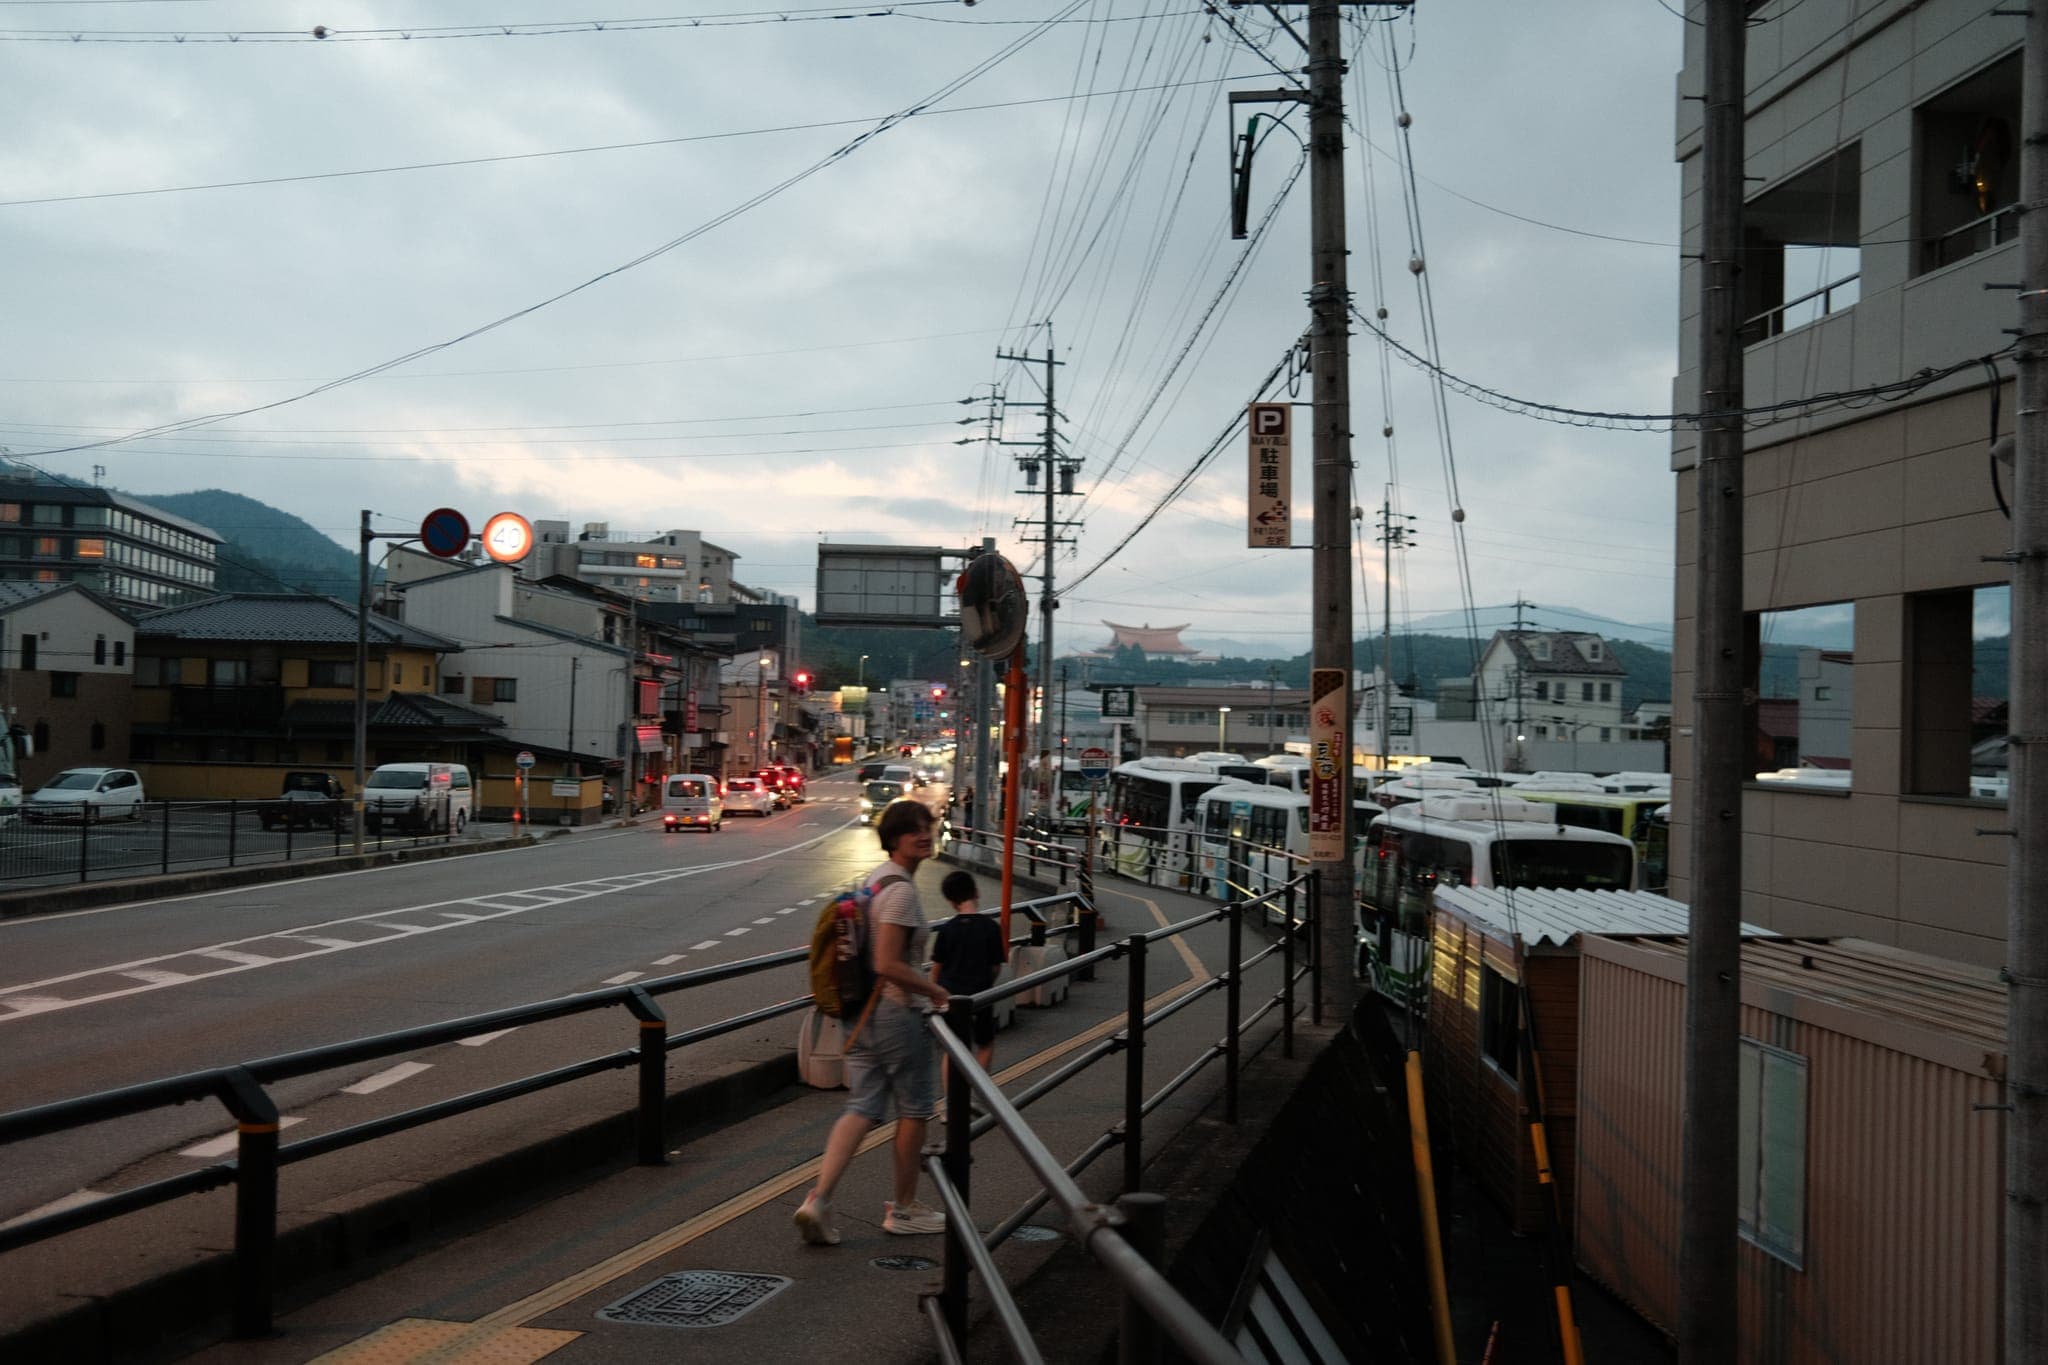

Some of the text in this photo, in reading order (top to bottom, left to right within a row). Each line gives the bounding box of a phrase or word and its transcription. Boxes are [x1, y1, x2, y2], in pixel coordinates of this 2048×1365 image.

[1258, 410, 1282, 433] P
[1259, 447, 1280, 498] 駐車場
[493, 527, 522, 549] 40
